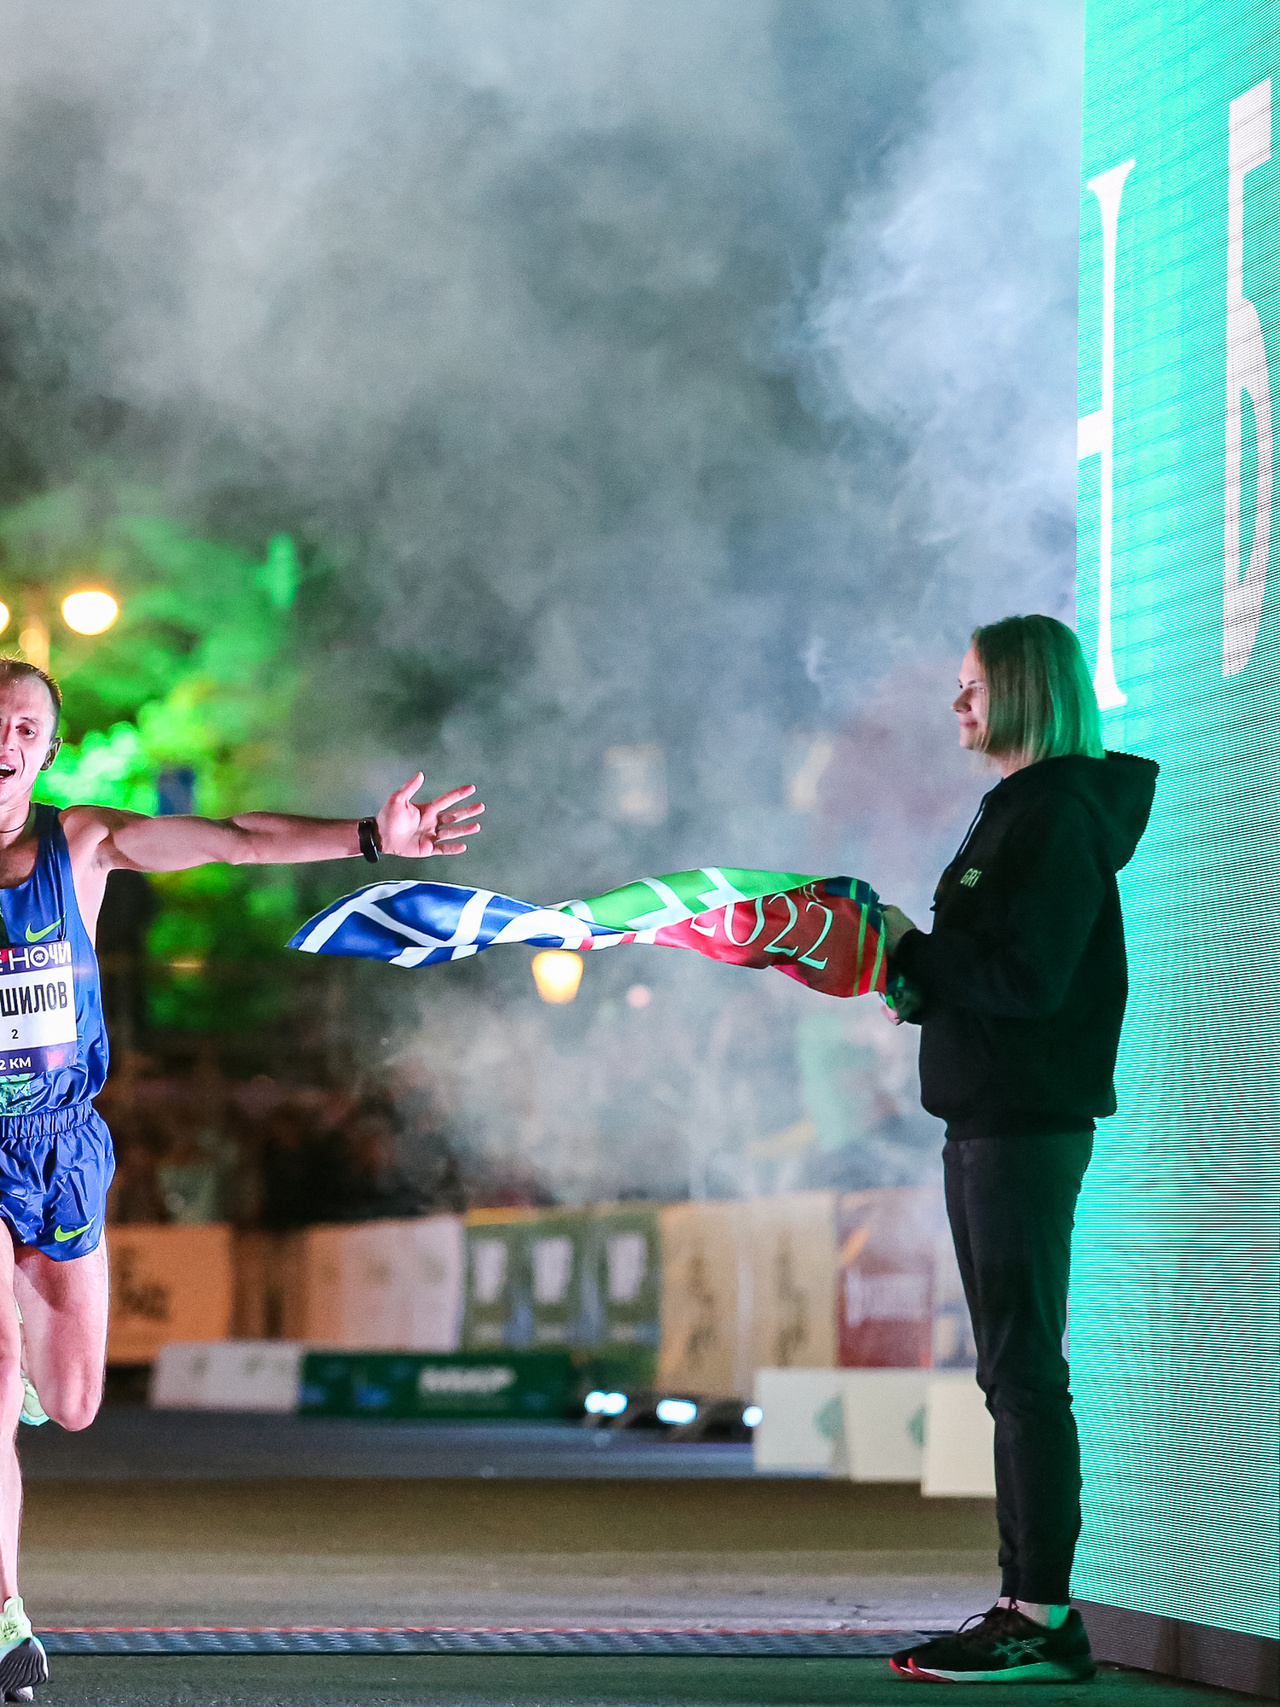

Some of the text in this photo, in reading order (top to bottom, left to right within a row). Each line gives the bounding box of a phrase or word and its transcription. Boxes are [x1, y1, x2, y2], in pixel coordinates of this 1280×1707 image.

[8, 941, 72, 971] НОЧИ
[11, 1029, 19, 1040] 2
[9, 1057, 32, 1070] КМ
